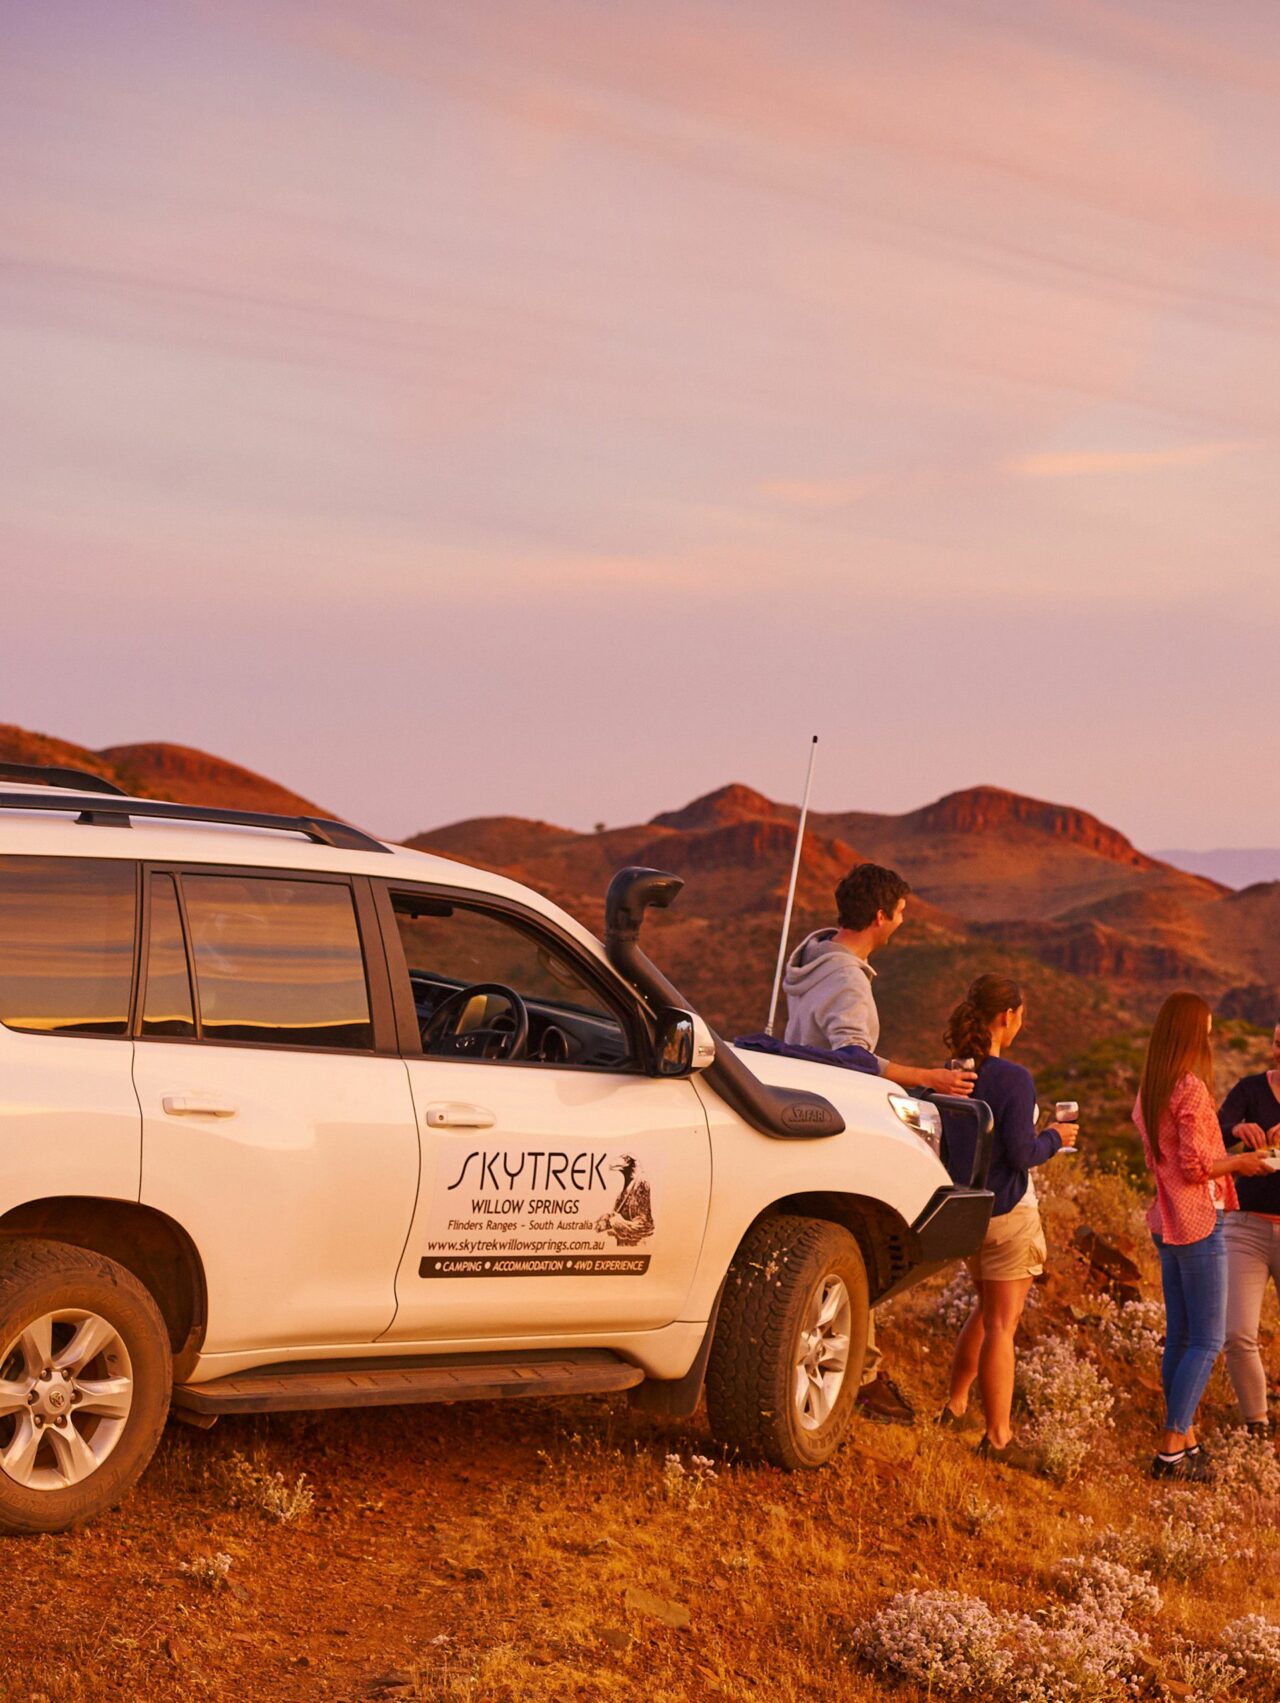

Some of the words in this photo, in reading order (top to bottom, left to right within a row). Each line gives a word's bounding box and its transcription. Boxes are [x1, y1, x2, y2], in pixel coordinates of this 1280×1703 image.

[447, 1151, 607, 1190] SKYTREK
[471, 1199, 524, 1214] WILLOW
[528, 1199, 579, 1215] SPRINGS
[448, 1220, 483, 1231] Flinders
[486, 1220, 517, 1232] Ranges
[529, 1219, 553, 1230] South
[556, 1219, 593, 1230] Australia
[428, 1238, 605, 1253] www.skytrekwillowsprings.com.au
[442, 1260, 482, 1272] CAMPING
[574, 1260, 593, 1270] 4WD
[594, 1260, 644, 1271] EXPERIENCE
